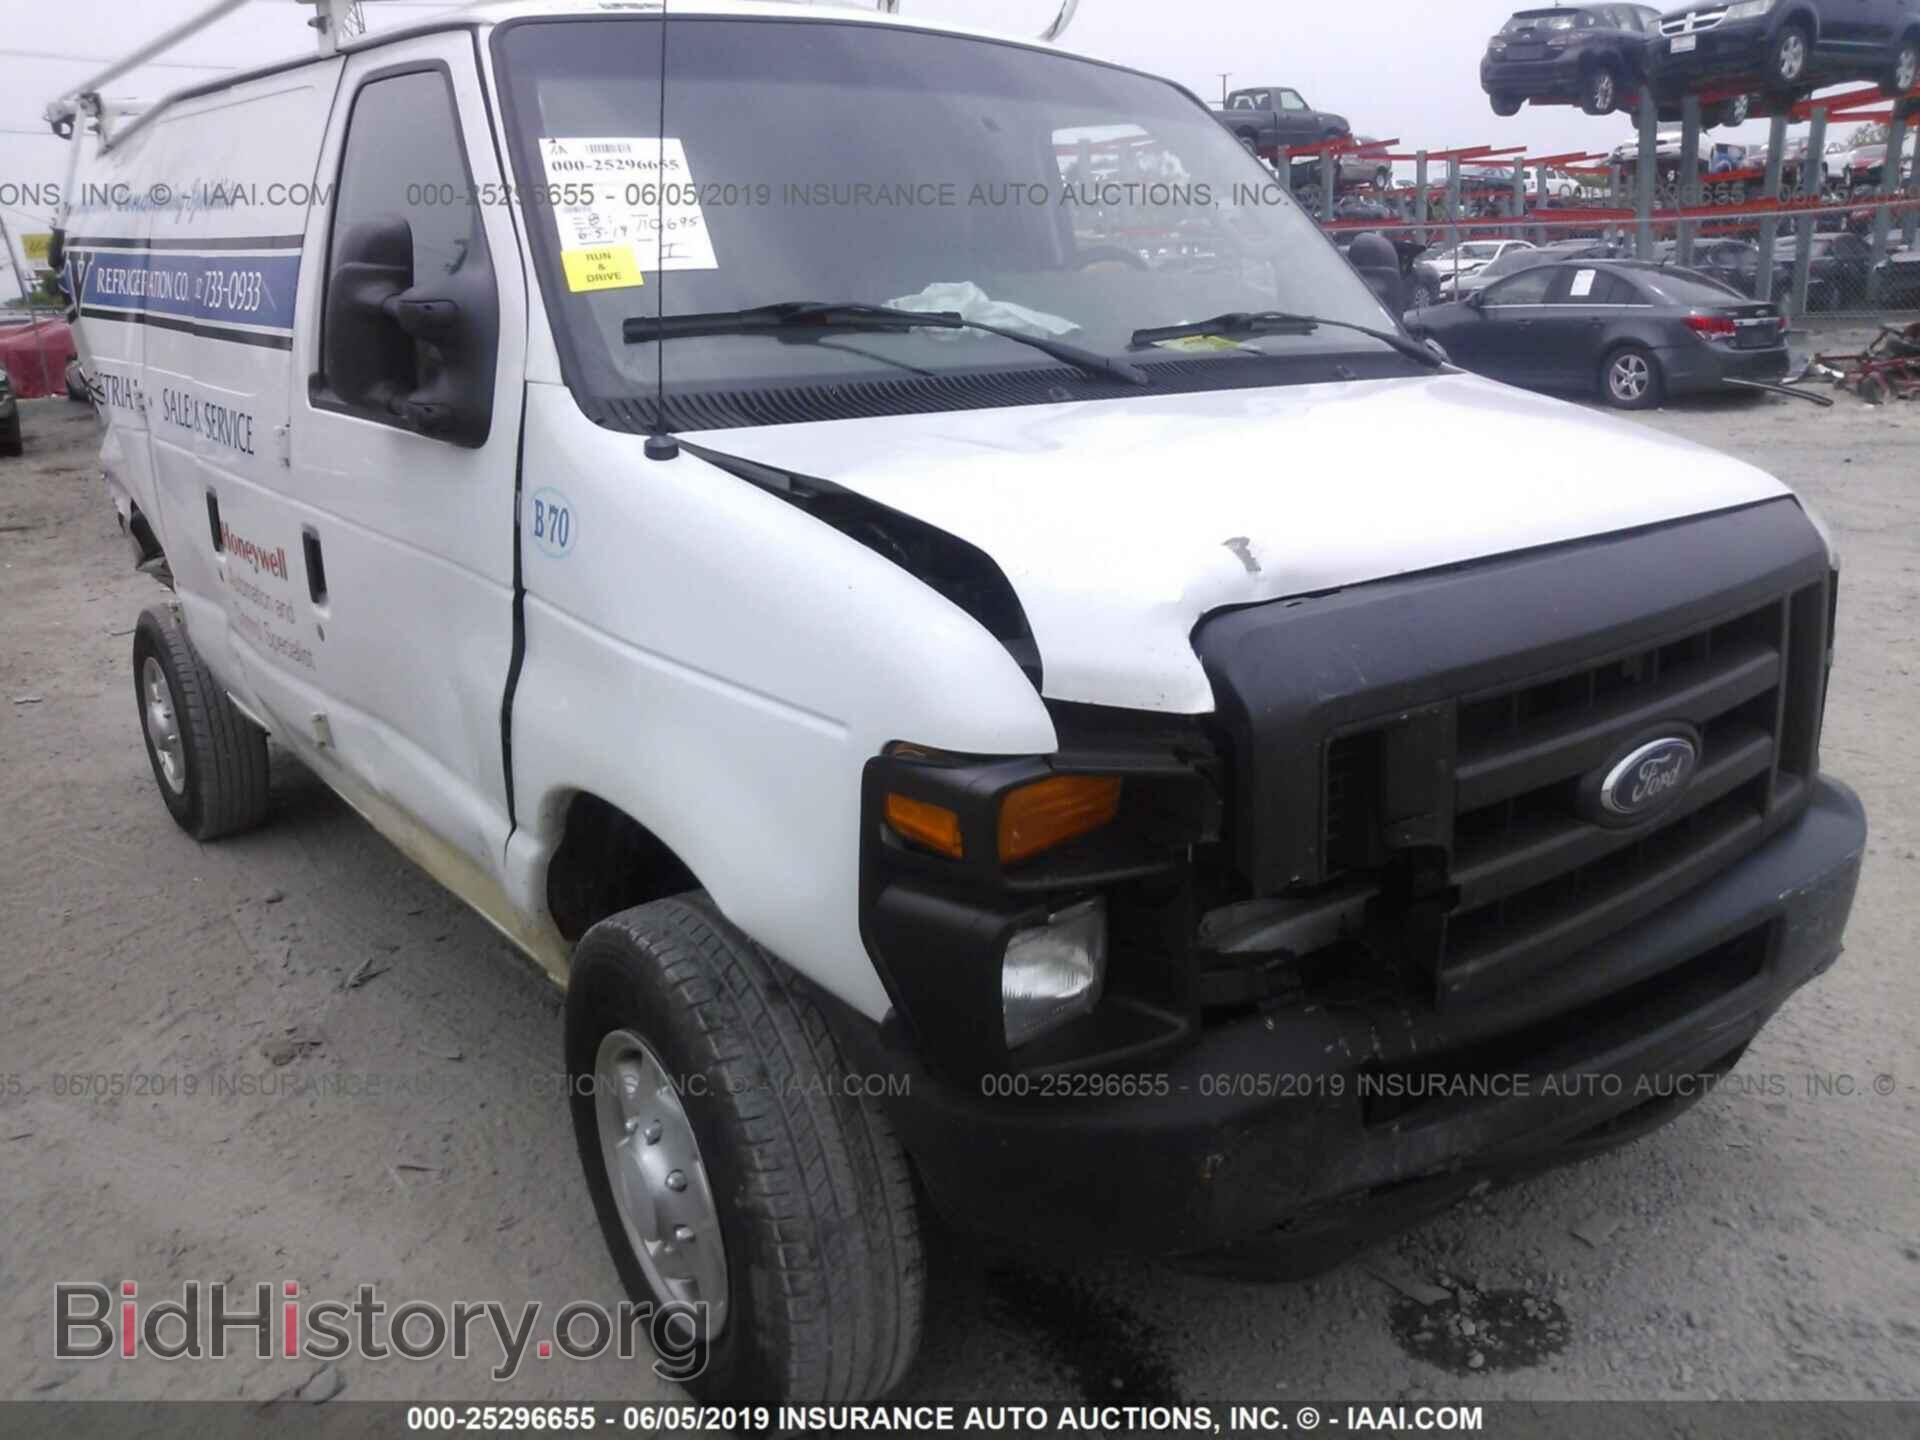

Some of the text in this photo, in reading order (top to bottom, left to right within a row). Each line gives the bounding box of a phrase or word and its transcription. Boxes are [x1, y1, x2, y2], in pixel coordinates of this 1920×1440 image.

[586, 252, 612, 261] RUN
[586, 271, 623, 284] DRIVE
[203, 270, 263, 312] 733-0933
[204, 401, 256, 456] SERVICE
[220, 519, 289, 582] Honeywell
[1632, 752, 1682, 802] Ford
